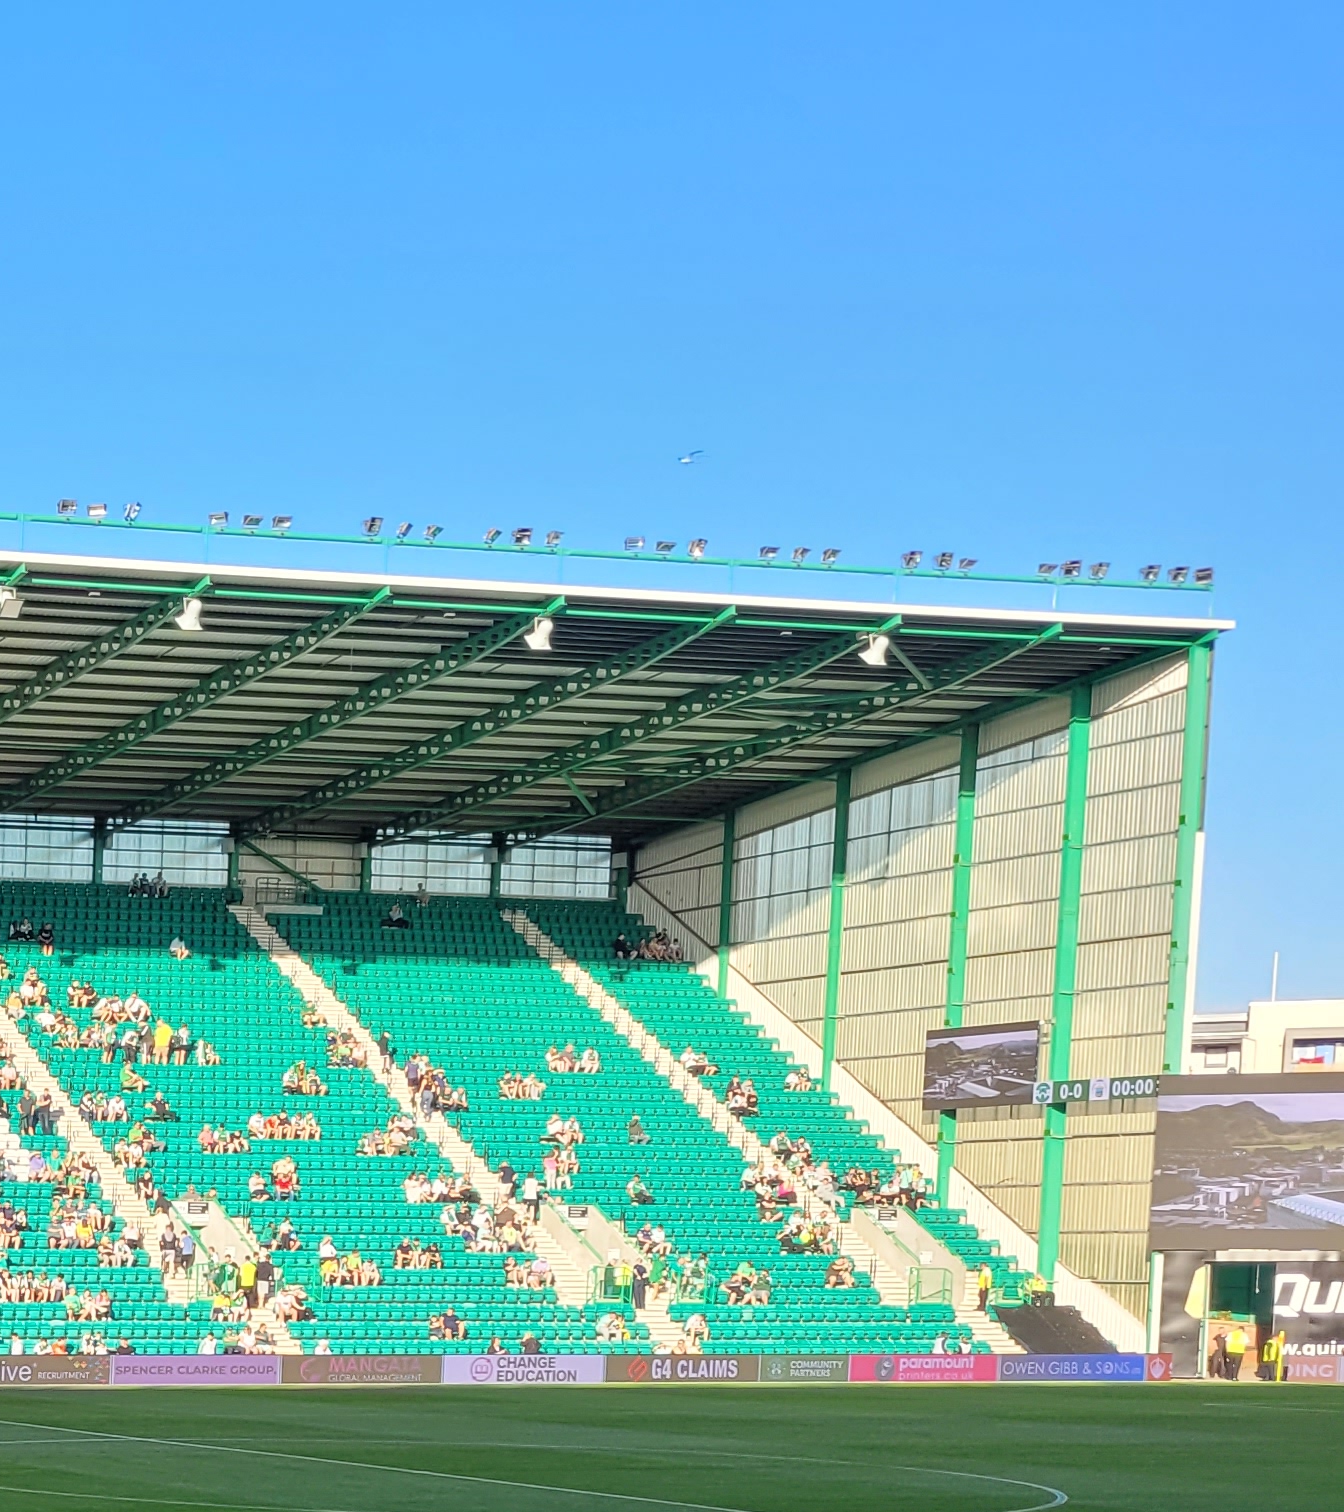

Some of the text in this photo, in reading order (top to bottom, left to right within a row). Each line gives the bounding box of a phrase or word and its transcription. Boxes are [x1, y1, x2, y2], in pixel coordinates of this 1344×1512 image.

[1059, 1079, 1154, 1099] 0-0 00:00
[329, 1357, 421, 1372] MANGATA
[497, 1357, 556, 1368] CHANGE
[790, 1361, 844, 1369] COMMUNITY
[899, 1356, 974, 1370] paramount
[1002, 1362, 1045, 1376] OWEN
[1049, 1362, 1078, 1375] GIBB
[1083, 1362, 1092, 1375] &
[1096, 1361, 1130, 1375] SONS
[38, 1371, 90, 1380] RECRUITMENT
[116, 1366, 173, 1376] SPENCER
[178, 1365, 226, 1375] CLARKE
[652, 1360, 738, 1379] G4 CLAIMS
[790, 1369, 831, 1377] PARTNERS
[496, 1370, 577, 1382] EDUCATION
